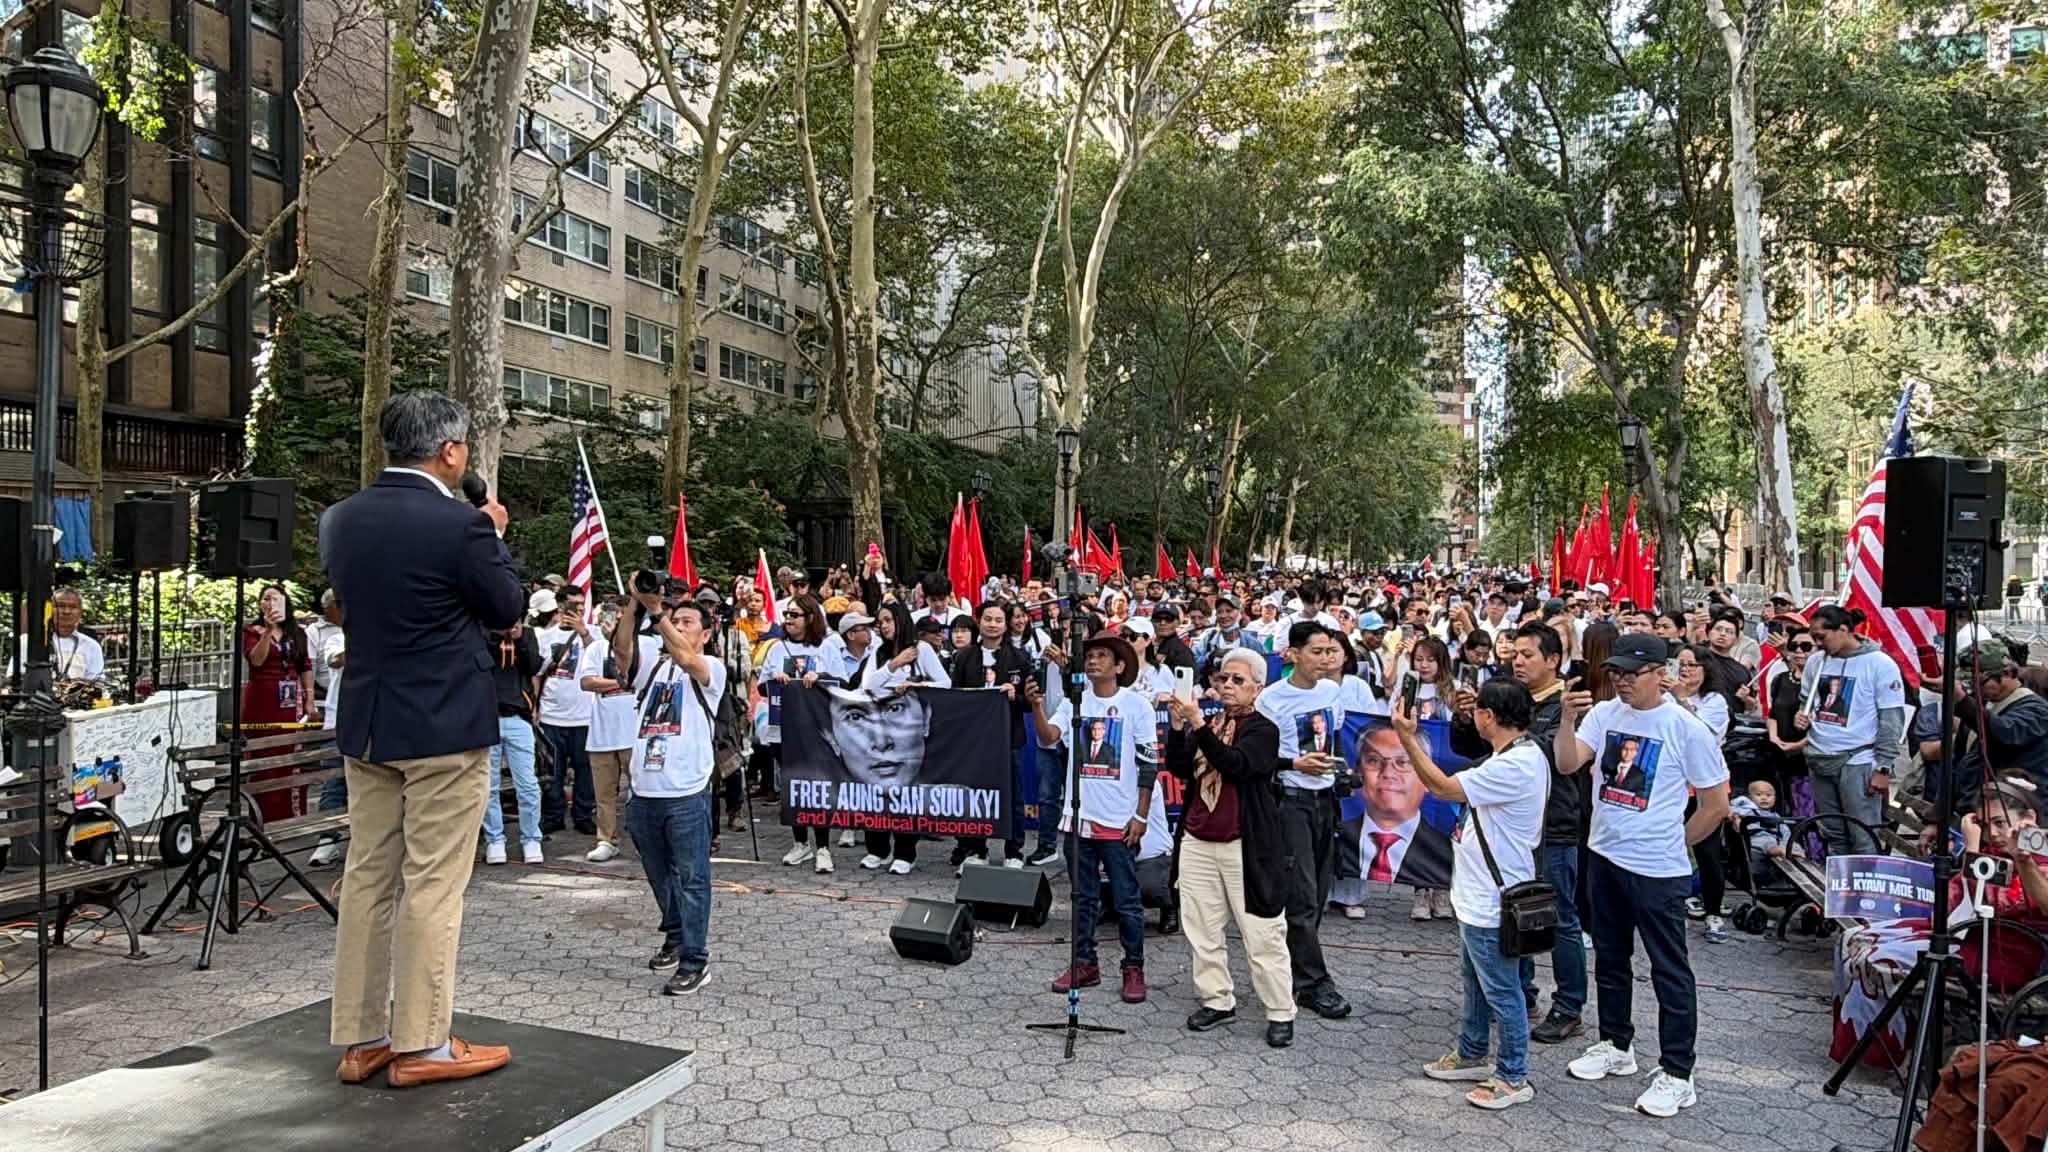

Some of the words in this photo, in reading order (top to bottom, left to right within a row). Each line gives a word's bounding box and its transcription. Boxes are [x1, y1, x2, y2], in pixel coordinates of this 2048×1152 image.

[790, 779, 832, 809] FREE
[837, 782, 884, 812] AUNG
[888, 784, 925, 816] SAN
[929, 786, 964, 817] SUU
[969, 788, 1000, 820] KYI
[796, 811, 826, 826] and
[829, 811, 849, 827] All
[854, 813, 914, 831] Political
[917, 816, 993, 837] Prisoners
[1853, 878, 1886, 893] KYAW
[1888, 881, 1914, 898] MOE
